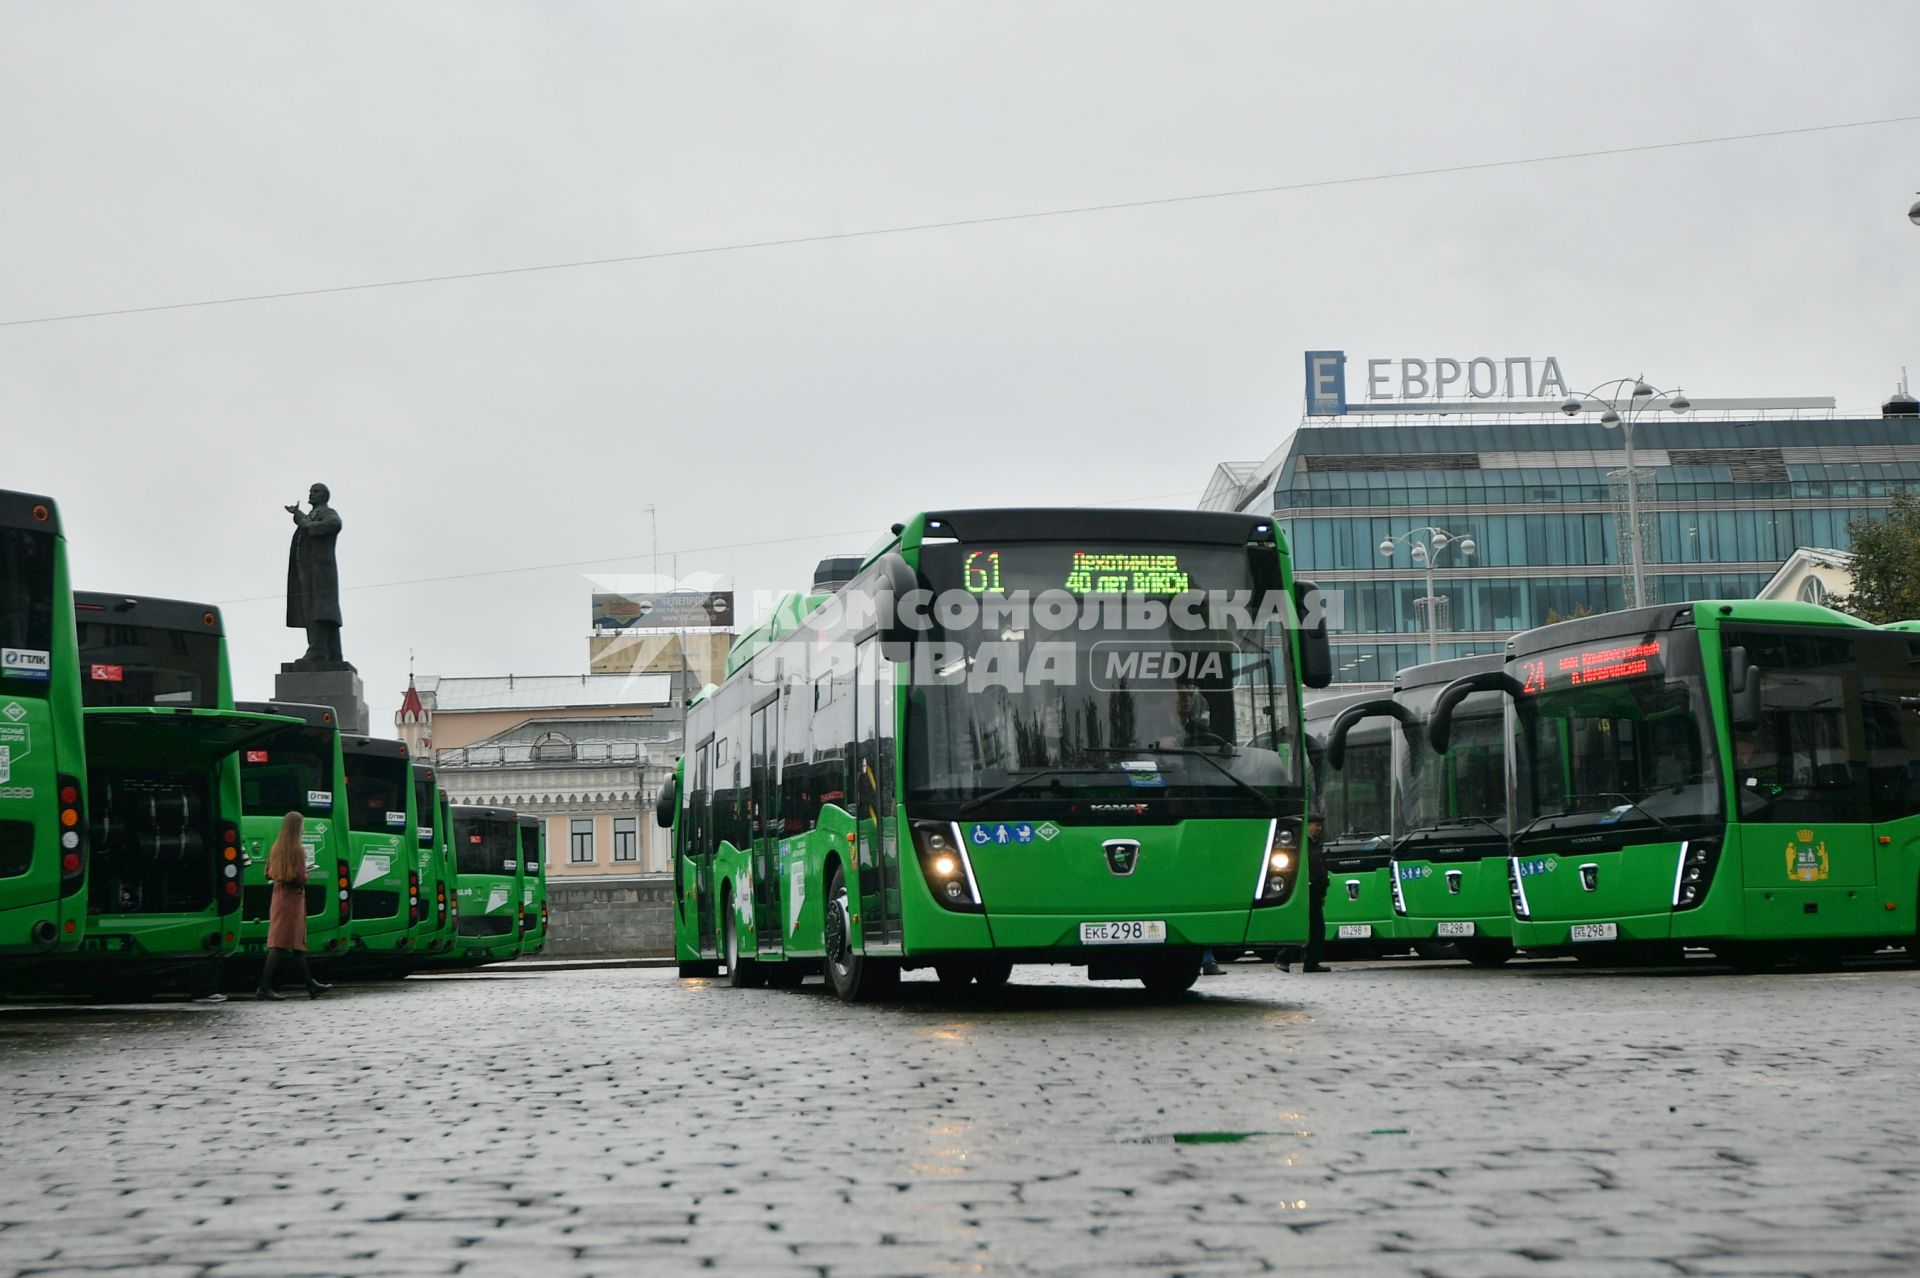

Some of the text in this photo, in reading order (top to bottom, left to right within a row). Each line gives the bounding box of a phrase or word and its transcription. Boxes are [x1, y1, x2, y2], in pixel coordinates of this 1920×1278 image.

[1368, 356, 1568, 399] ЕВРОПА
[964, 552, 1004, 593] 61
[1073, 552, 1178, 571] Пехотинцев
[1065, 572, 1189, 593] 40 лет ВЛКСМ
[20, 654, 47, 665] ГТЛК
[1523, 660, 1546, 694] 24
